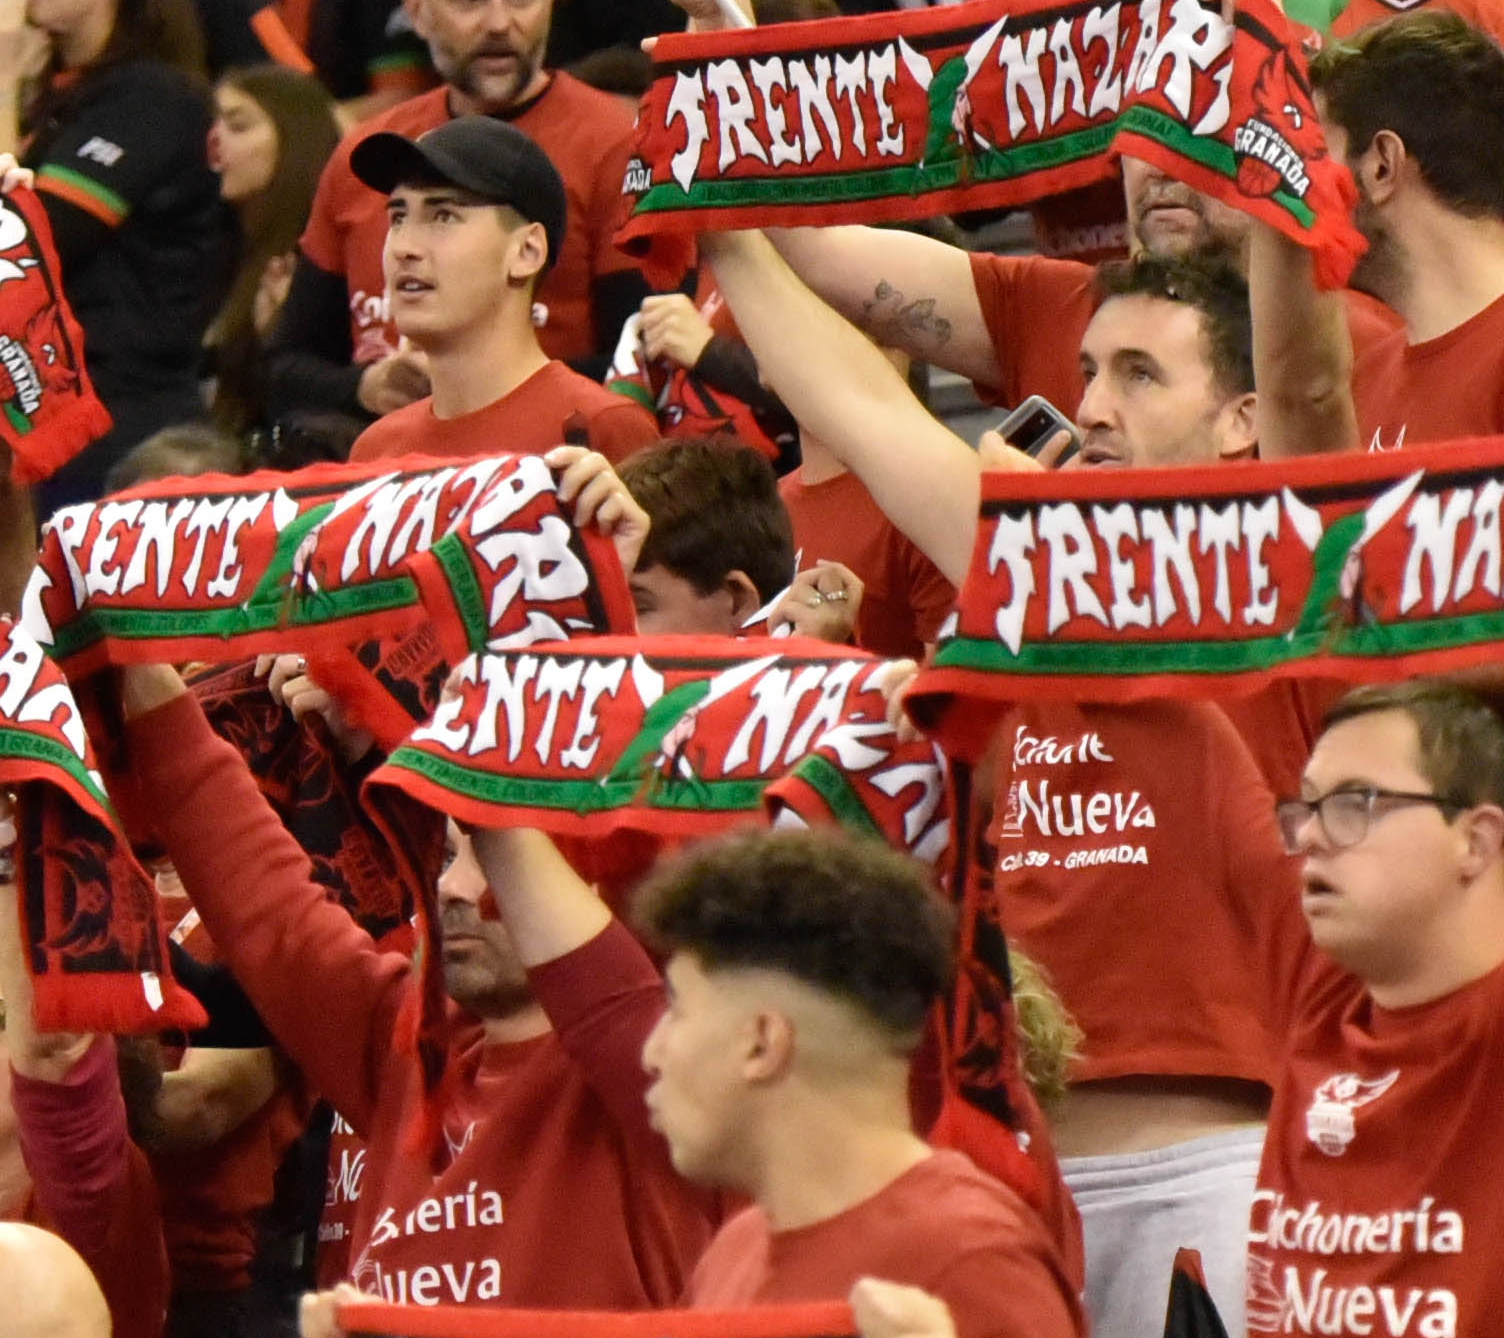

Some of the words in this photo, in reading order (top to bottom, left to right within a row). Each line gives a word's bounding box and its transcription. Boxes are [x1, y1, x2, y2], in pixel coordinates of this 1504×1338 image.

[665, 45, 906, 195] FRENTE
[1235, 127, 1310, 198] GRANADA
[988, 494, 1280, 657] FRENTE
[1017, 779, 1156, 837] Nueva
[1025, 850, 1050, 868] 39
[1064, 844, 1149, 870] GRANADA
